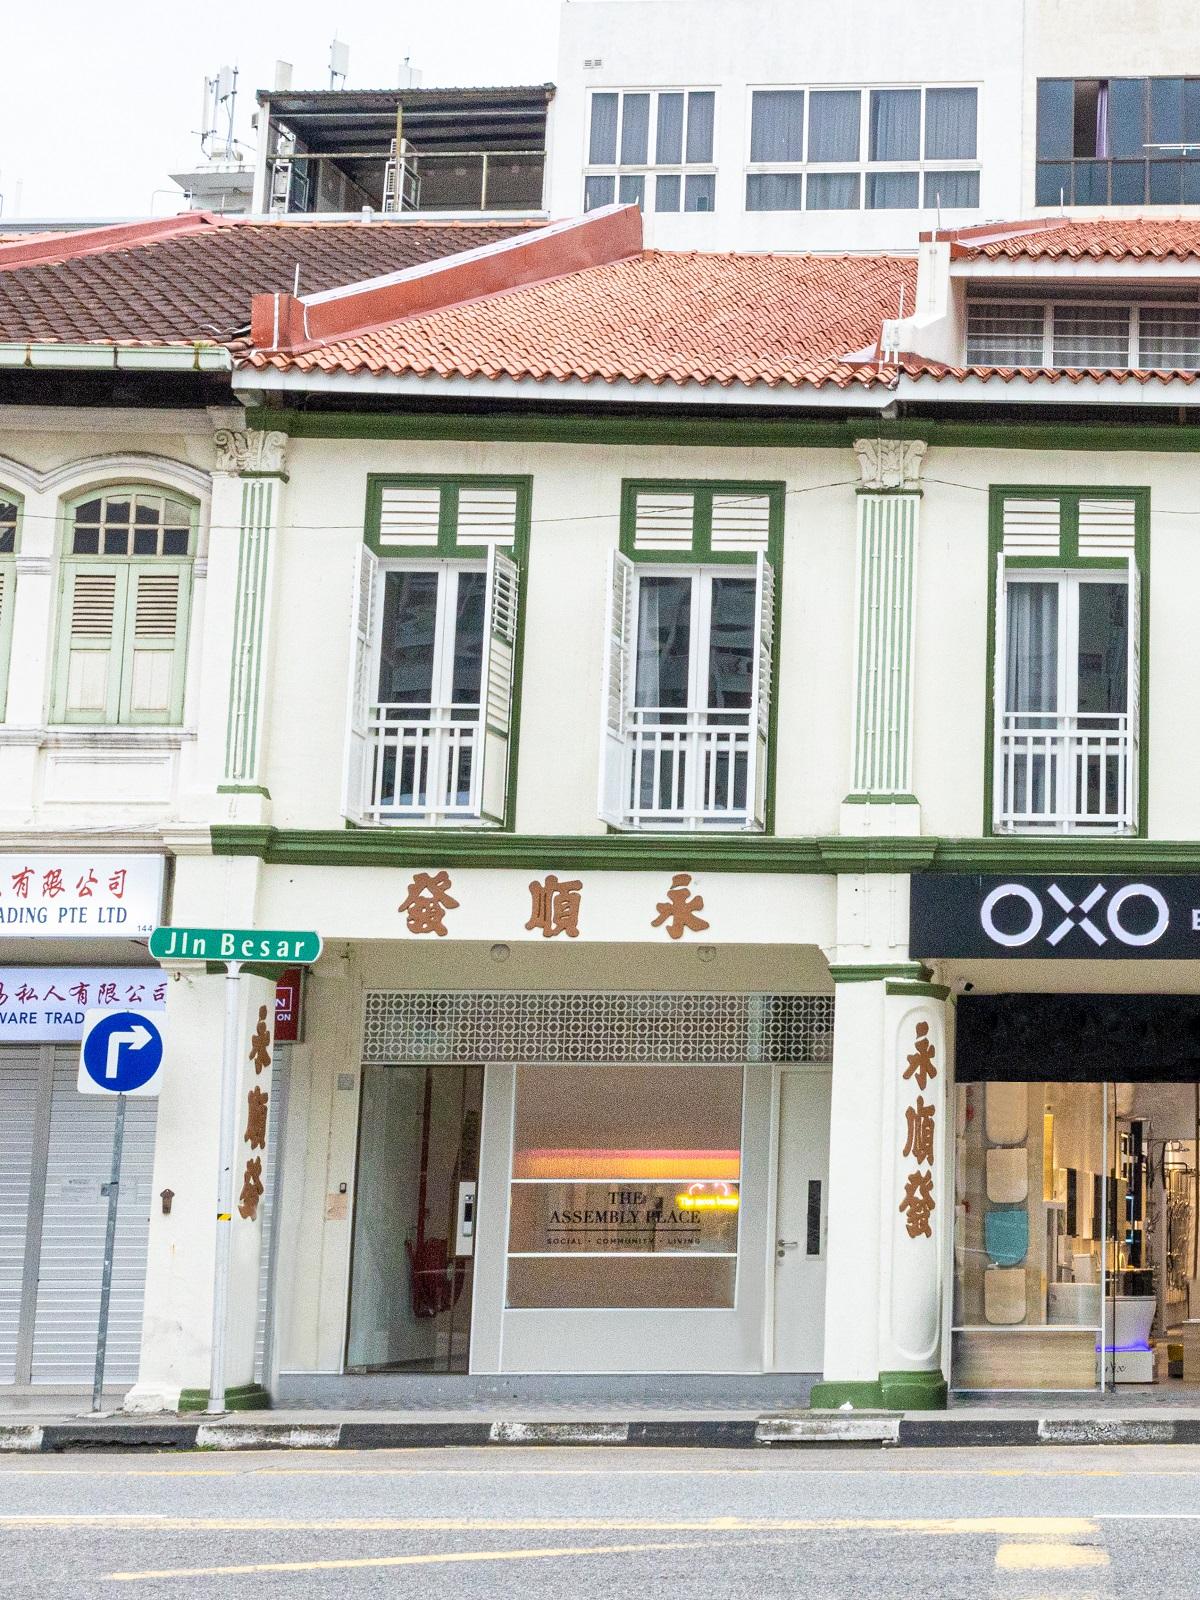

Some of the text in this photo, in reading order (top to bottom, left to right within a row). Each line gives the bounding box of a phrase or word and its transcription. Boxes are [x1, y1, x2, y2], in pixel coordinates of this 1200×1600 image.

[0, 866, 127, 898] 有限公司
[58, 907, 88, 923] PTE
[97, 907, 127, 923] LTD
[980, 883, 1170, 947] OXO
[165, 932, 305, 958] Jln Besar
[608, 1191, 644, 1205] THE
[550, 1210, 701, 1224] ASSEMBLY PLACE
